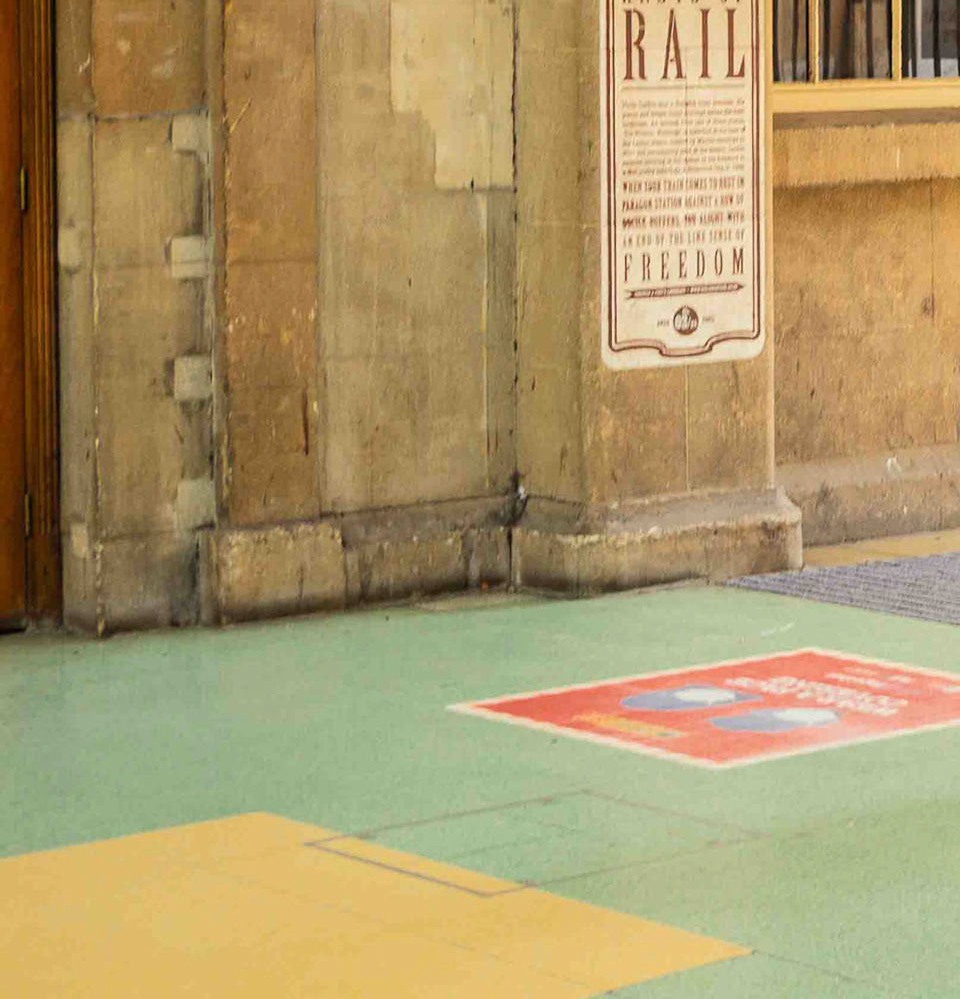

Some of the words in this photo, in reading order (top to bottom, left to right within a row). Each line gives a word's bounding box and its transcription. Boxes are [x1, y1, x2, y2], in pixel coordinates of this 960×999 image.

[623, 8, 746, 80] RAIL
[663, 178, 684, 191] TRAIN
[622, 198, 652, 212] PARAGON
[654, 196, 682, 210] STATION
[684, 195, 711, 208] AGAINST
[727, 210, 745, 223] WITH
[709, 229, 732, 242] SENSE
[735, 228, 745, 241] OF
[623, 248, 745, 283] FREEDOM
